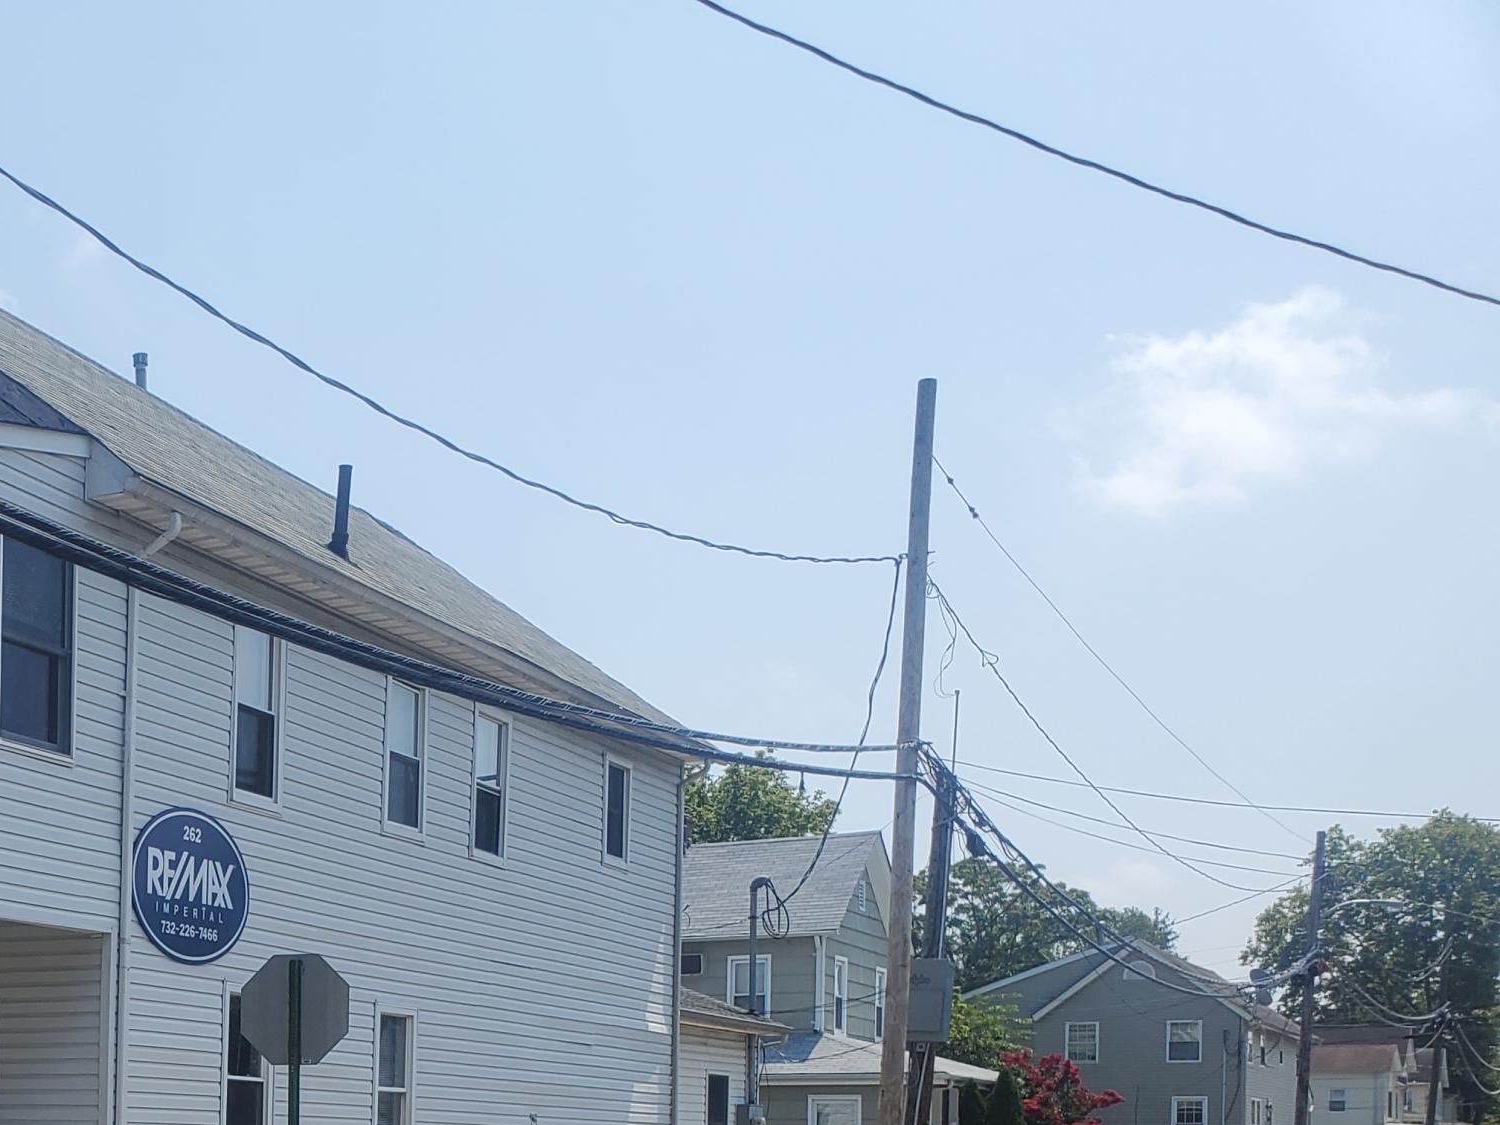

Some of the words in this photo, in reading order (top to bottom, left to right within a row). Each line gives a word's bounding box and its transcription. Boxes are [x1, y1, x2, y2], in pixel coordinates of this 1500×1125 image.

[183, 826, 201, 843] 262
[147, 846, 236, 910] RE/MAX
[155, 900, 223, 924] IMPERIAL
[161, 920, 218, 942] 732-226-7466
